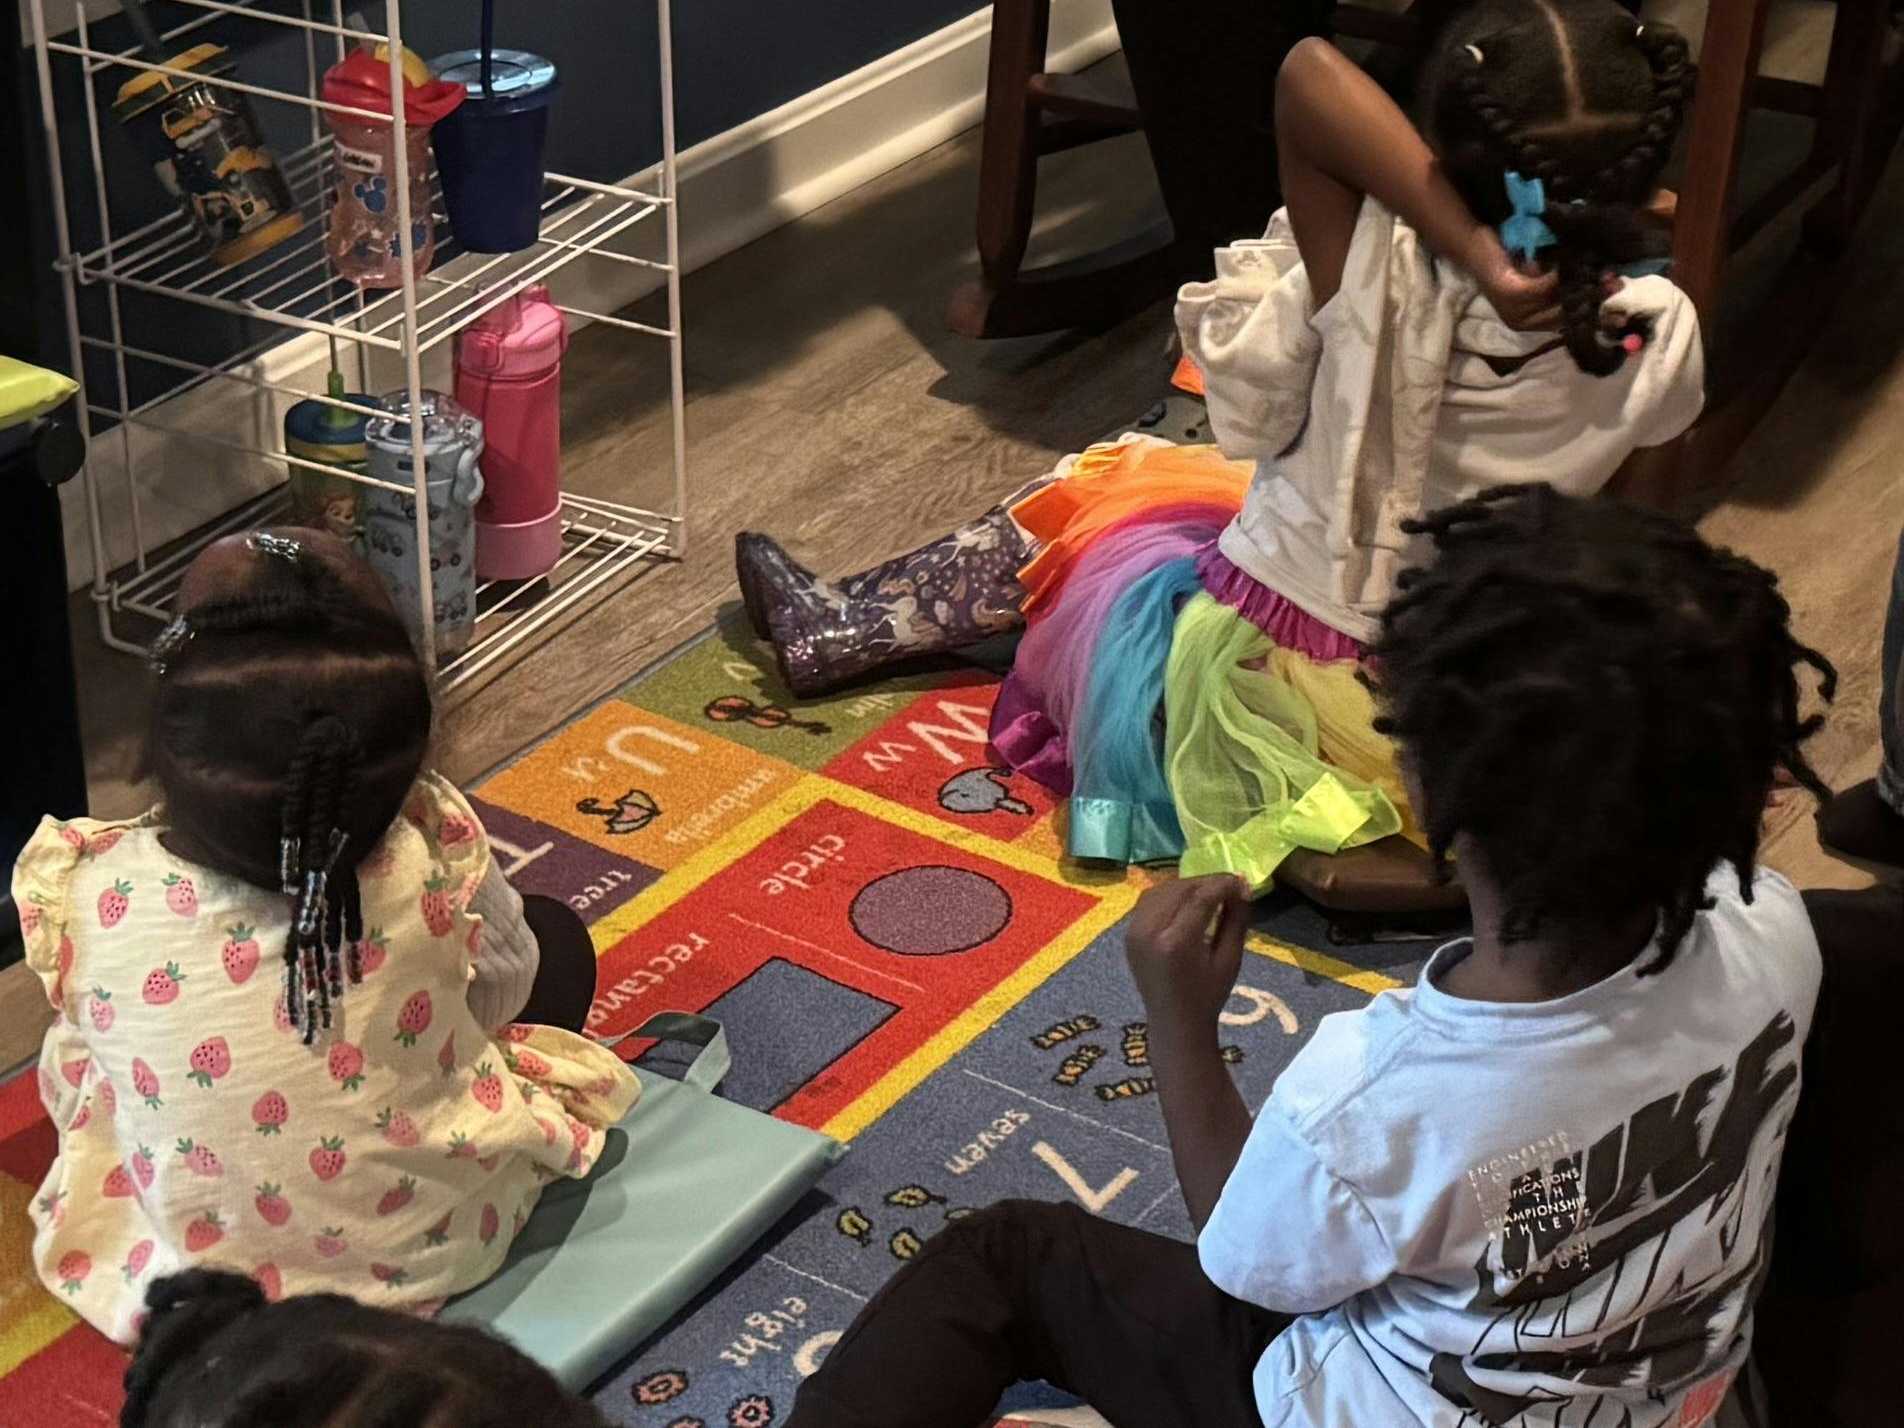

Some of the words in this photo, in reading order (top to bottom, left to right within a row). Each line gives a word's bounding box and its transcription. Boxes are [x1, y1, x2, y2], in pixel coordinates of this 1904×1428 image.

[605, 724, 701, 777] U
[907, 700, 992, 765] W
[569, 870, 633, 911] tree
[759, 833, 846, 896] circle
[945, 1107, 1034, 1176] seven
[1031, 1139, 1140, 1213] 7
[718, 1296, 807, 1367] eight
